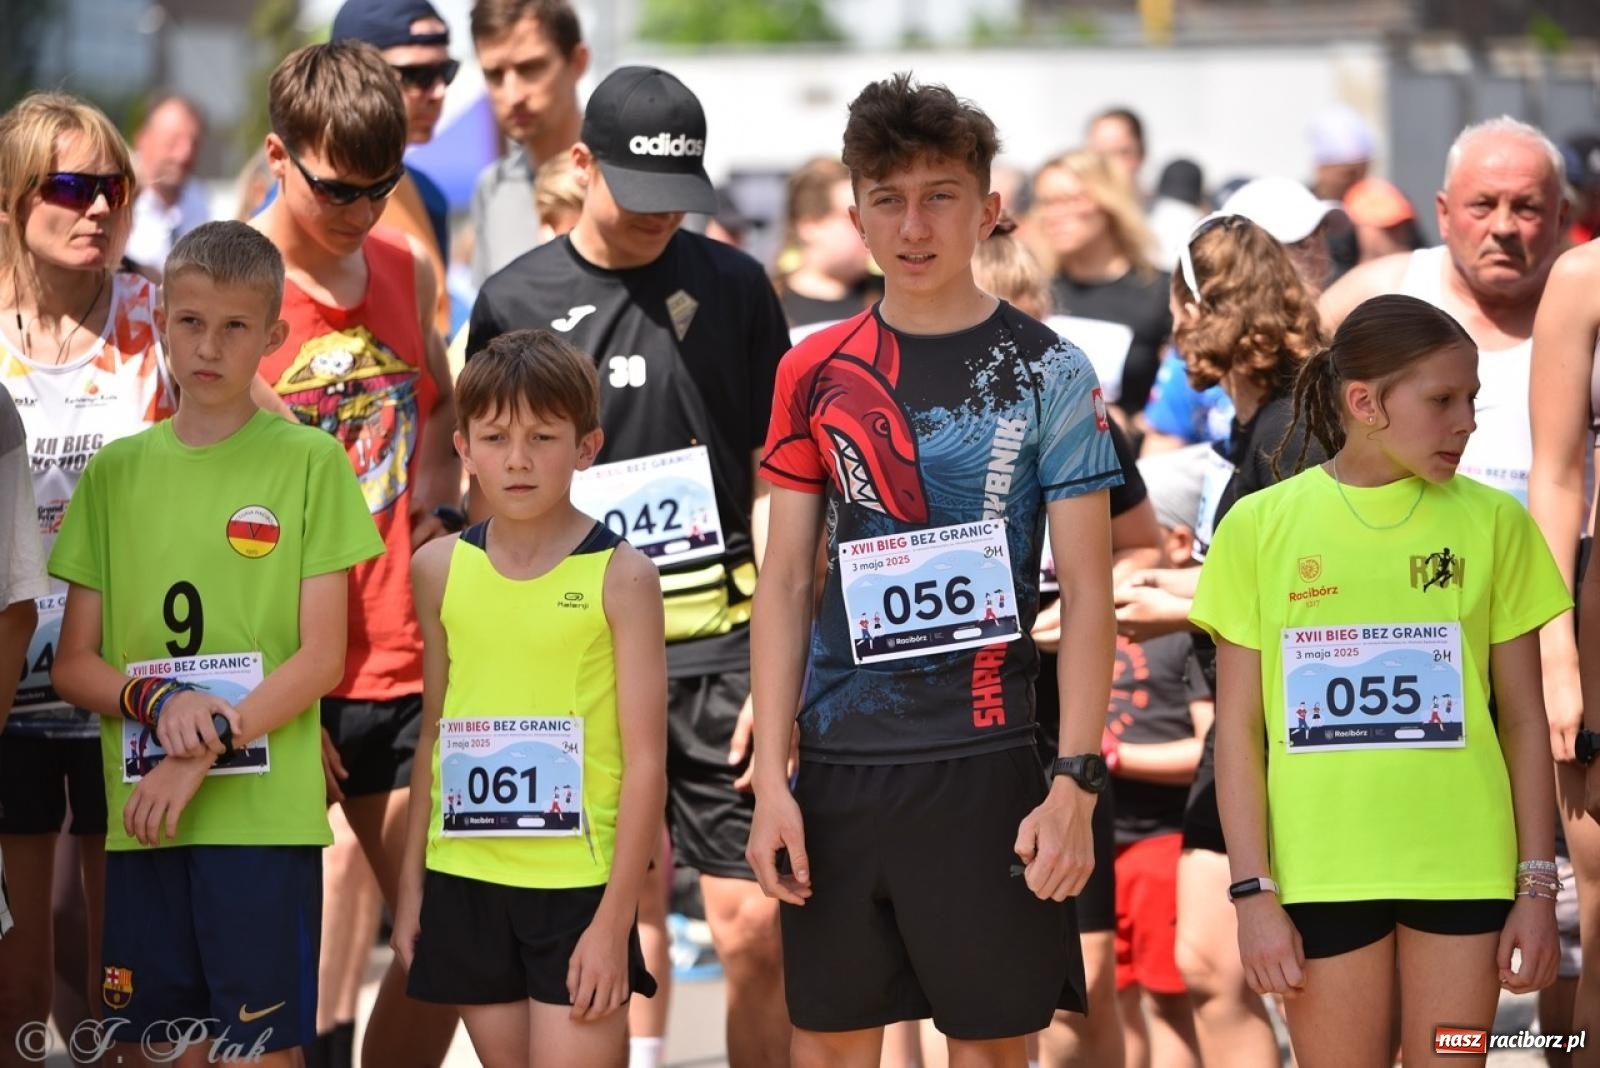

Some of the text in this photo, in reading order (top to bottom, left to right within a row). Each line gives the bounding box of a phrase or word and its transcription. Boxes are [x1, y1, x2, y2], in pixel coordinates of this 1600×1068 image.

[629, 133, 704, 158] adidas
[34, 433, 104, 455] XII BIEG
[604, 498, 682, 538] 042
[850, 542, 874, 556] XVII
[876, 537, 907, 551] BIEG
[911, 532, 936, 546] BEZ
[939, 523, 992, 541] GRANIC
[852, 555, 911, 571] 3 maja 2025
[883, 575, 975, 625] 056
[1289, 585, 1338, 602] Racibórz
[163, 580, 204, 658] 9
[1296, 626, 1448, 643] XVII BIEG BEZ GRANIC
[1295, 648, 1360, 661] 3 maja 2025
[133, 666, 148, 677] XVII
[149, 663, 172, 675] BIEG
[174, 660, 196, 673] BEZ
[199, 656, 252, 671] GRANIC
[1326, 675, 1422, 718] 055
[448, 720, 572, 733] XVII BIEG BEZ GRANIC
[1334, 729, 1369, 738] Racibórz
[452, 740, 470, 750] maja
[471, 738, 491, 749] 2025
[468, 765, 538, 805] 061
